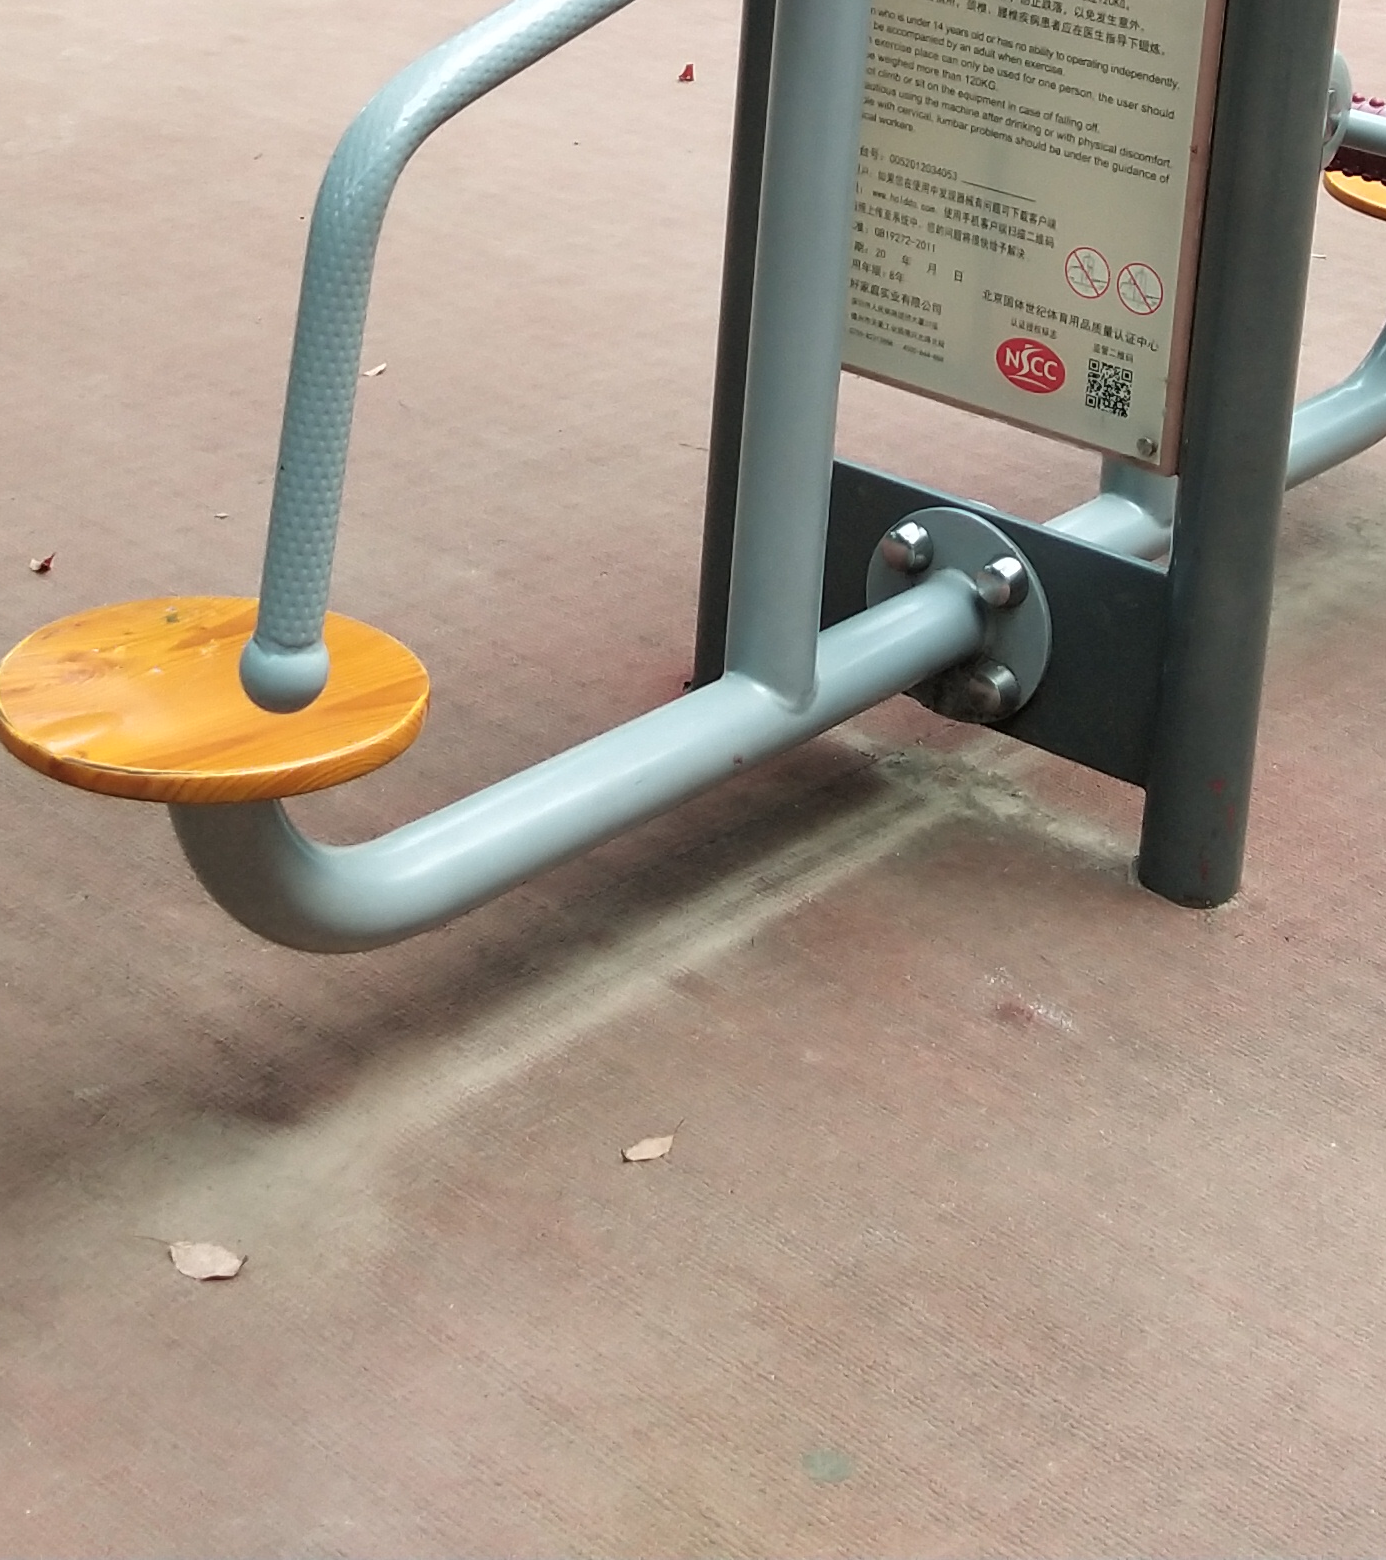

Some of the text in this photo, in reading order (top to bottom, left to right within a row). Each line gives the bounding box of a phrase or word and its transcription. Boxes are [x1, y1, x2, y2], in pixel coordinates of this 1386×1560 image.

[873, 21, 884, 31] be
[886, 26, 944, 45] accompanied
[947, 40, 957, 51] by
[960, 44, 970, 52] an
[974, 45, 995, 59] adult
[998, 52, 1022, 66] when
[907, 16, 930, 27] under
[934, 22, 943, 30] 14
[945, 26, 968, 37] years
[1015, 42, 1026, 51] no
[1029, 45, 1054, 60] ability
[1056, 51, 1064, 60] to
[1067, 54, 1108, 73] operating
[917, 64, 939, 76] more
[942, 70, 961, 81] than
[878, 69, 900, 82] climb
[903, 76, 913, 84] or
[915, 78, 924, 87] sit
[928, 82, 938, 91] on
[942, 85, 955, 96] the
[958, 90, 1005, 110] equipment
[1008, 100, 1016, 111] in
[1019, 106, 1040, 117] case
[1043, 111, 1053, 120] of
[1056, 113, 1082, 131] falling
[915, 47, 939, 60] place
[942, 54, 958, 64] can
[961, 59, 980, 72] only
[983, 64, 994, 74] be
[997, 68, 1020, 81] used
[1023, 73, 1035, 84] for
[1038, 79, 1056, 89] one
[1099, 93, 1113, 104] the
[1117, 99, 1138, 111] user
[1141, 103, 1175, 120] should
[878, 101, 895, 111] with
[937, 115, 968, 130] lumbar
[970, 125, 1012, 142] problems
[1016, 136, 1046, 151] should
[1049, 145, 1060, 155] be
[1064, 150, 1091, 163] under
[1095, 157, 1109, 168] the
[1112, 162, 1156, 182] guidance
[1160, 174, 1169, 183] of
[899, 90, 923, 105] using
[925, 97, 938, 107] the
[942, 102, 979, 118] machine
[982, 112, 1003, 123] after
[1005, 117, 1041, 136] drinking
[1045, 128, 1054, 137] or
[1057, 132, 1075, 144] with
[1078, 135, 1117, 154] physical
[876, 248, 886, 259] 20
[927, 262, 937, 275] 月
[954, 270, 963, 282] 日
[983, 290, 1159, 352] 北京国体世纪体育用品质量认证中心
[1005, 344, 1058, 381] NSCC
